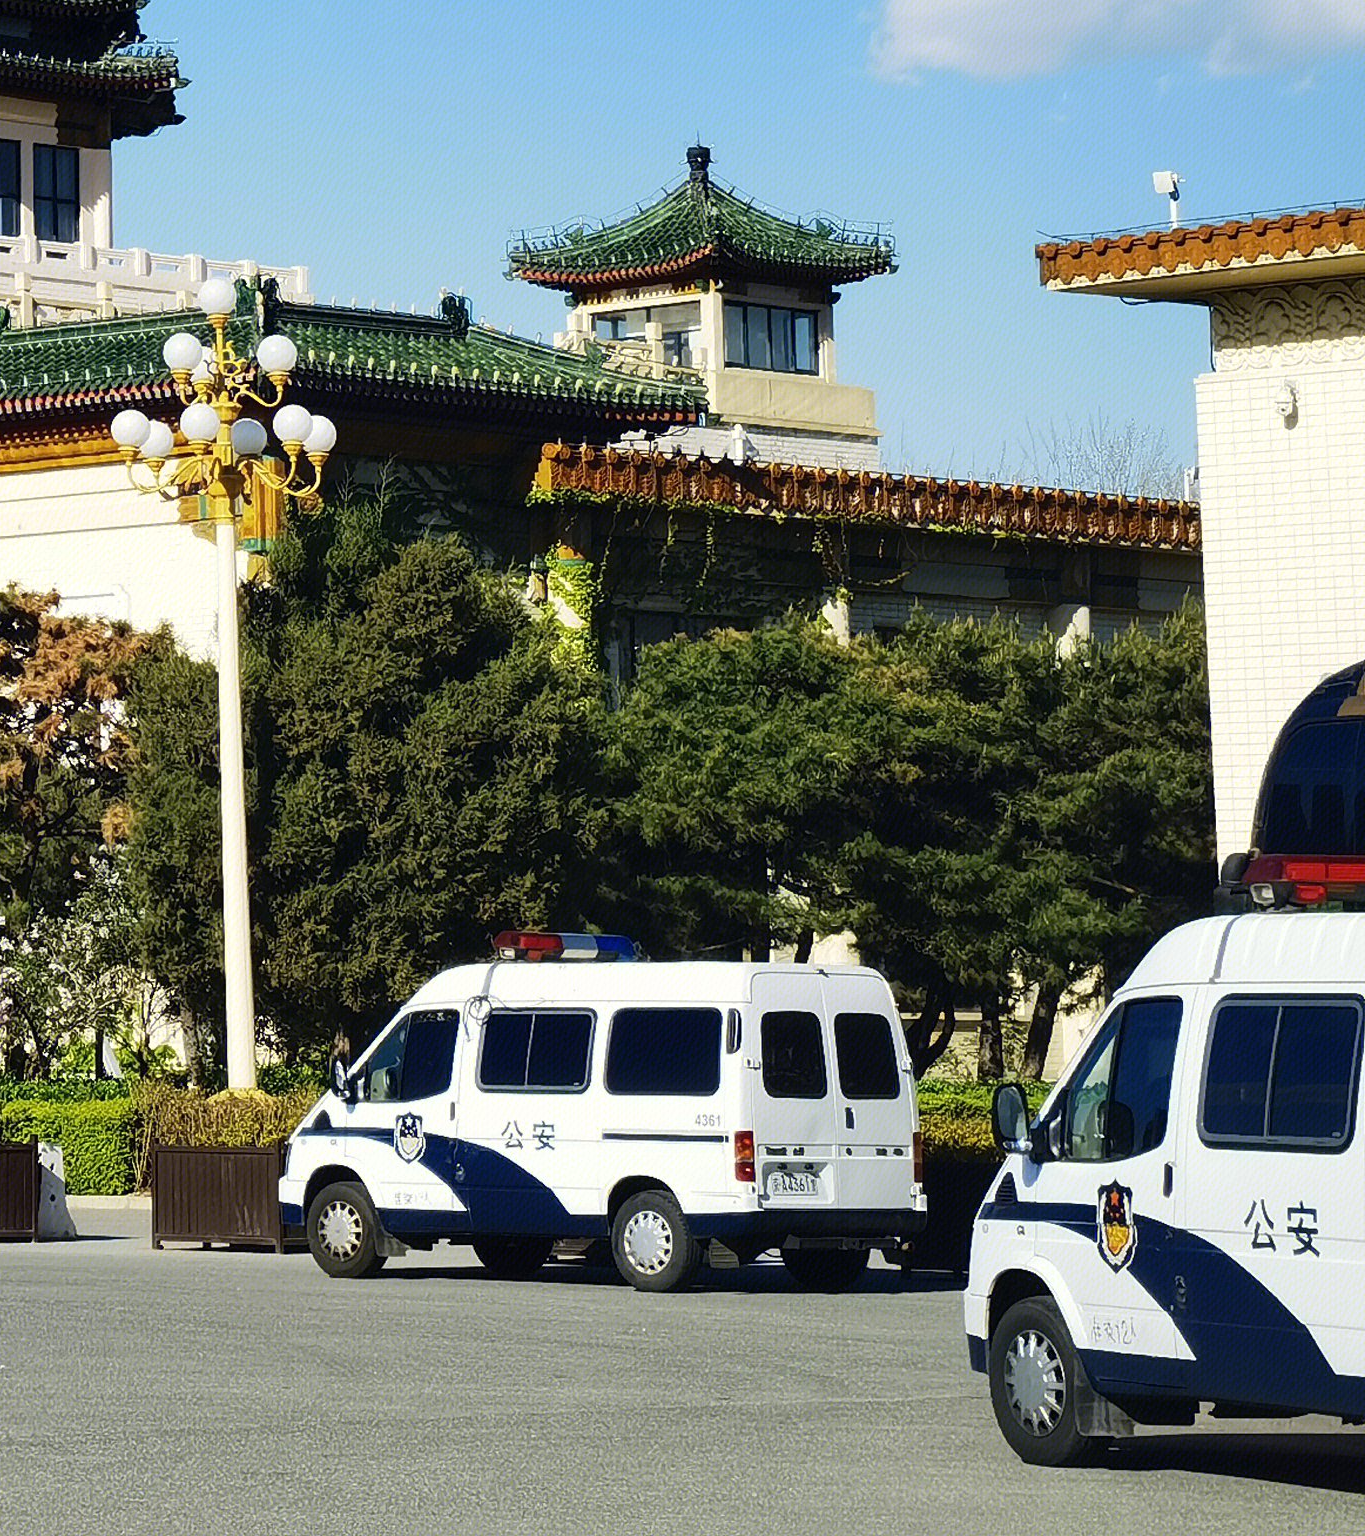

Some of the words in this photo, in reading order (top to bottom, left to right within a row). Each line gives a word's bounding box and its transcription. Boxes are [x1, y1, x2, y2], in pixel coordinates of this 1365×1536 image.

[501, 1120, 555, 1150] 公安
[695, 1114, 721, 1127] 4361
[1244, 1199, 1320, 1258] 公安
